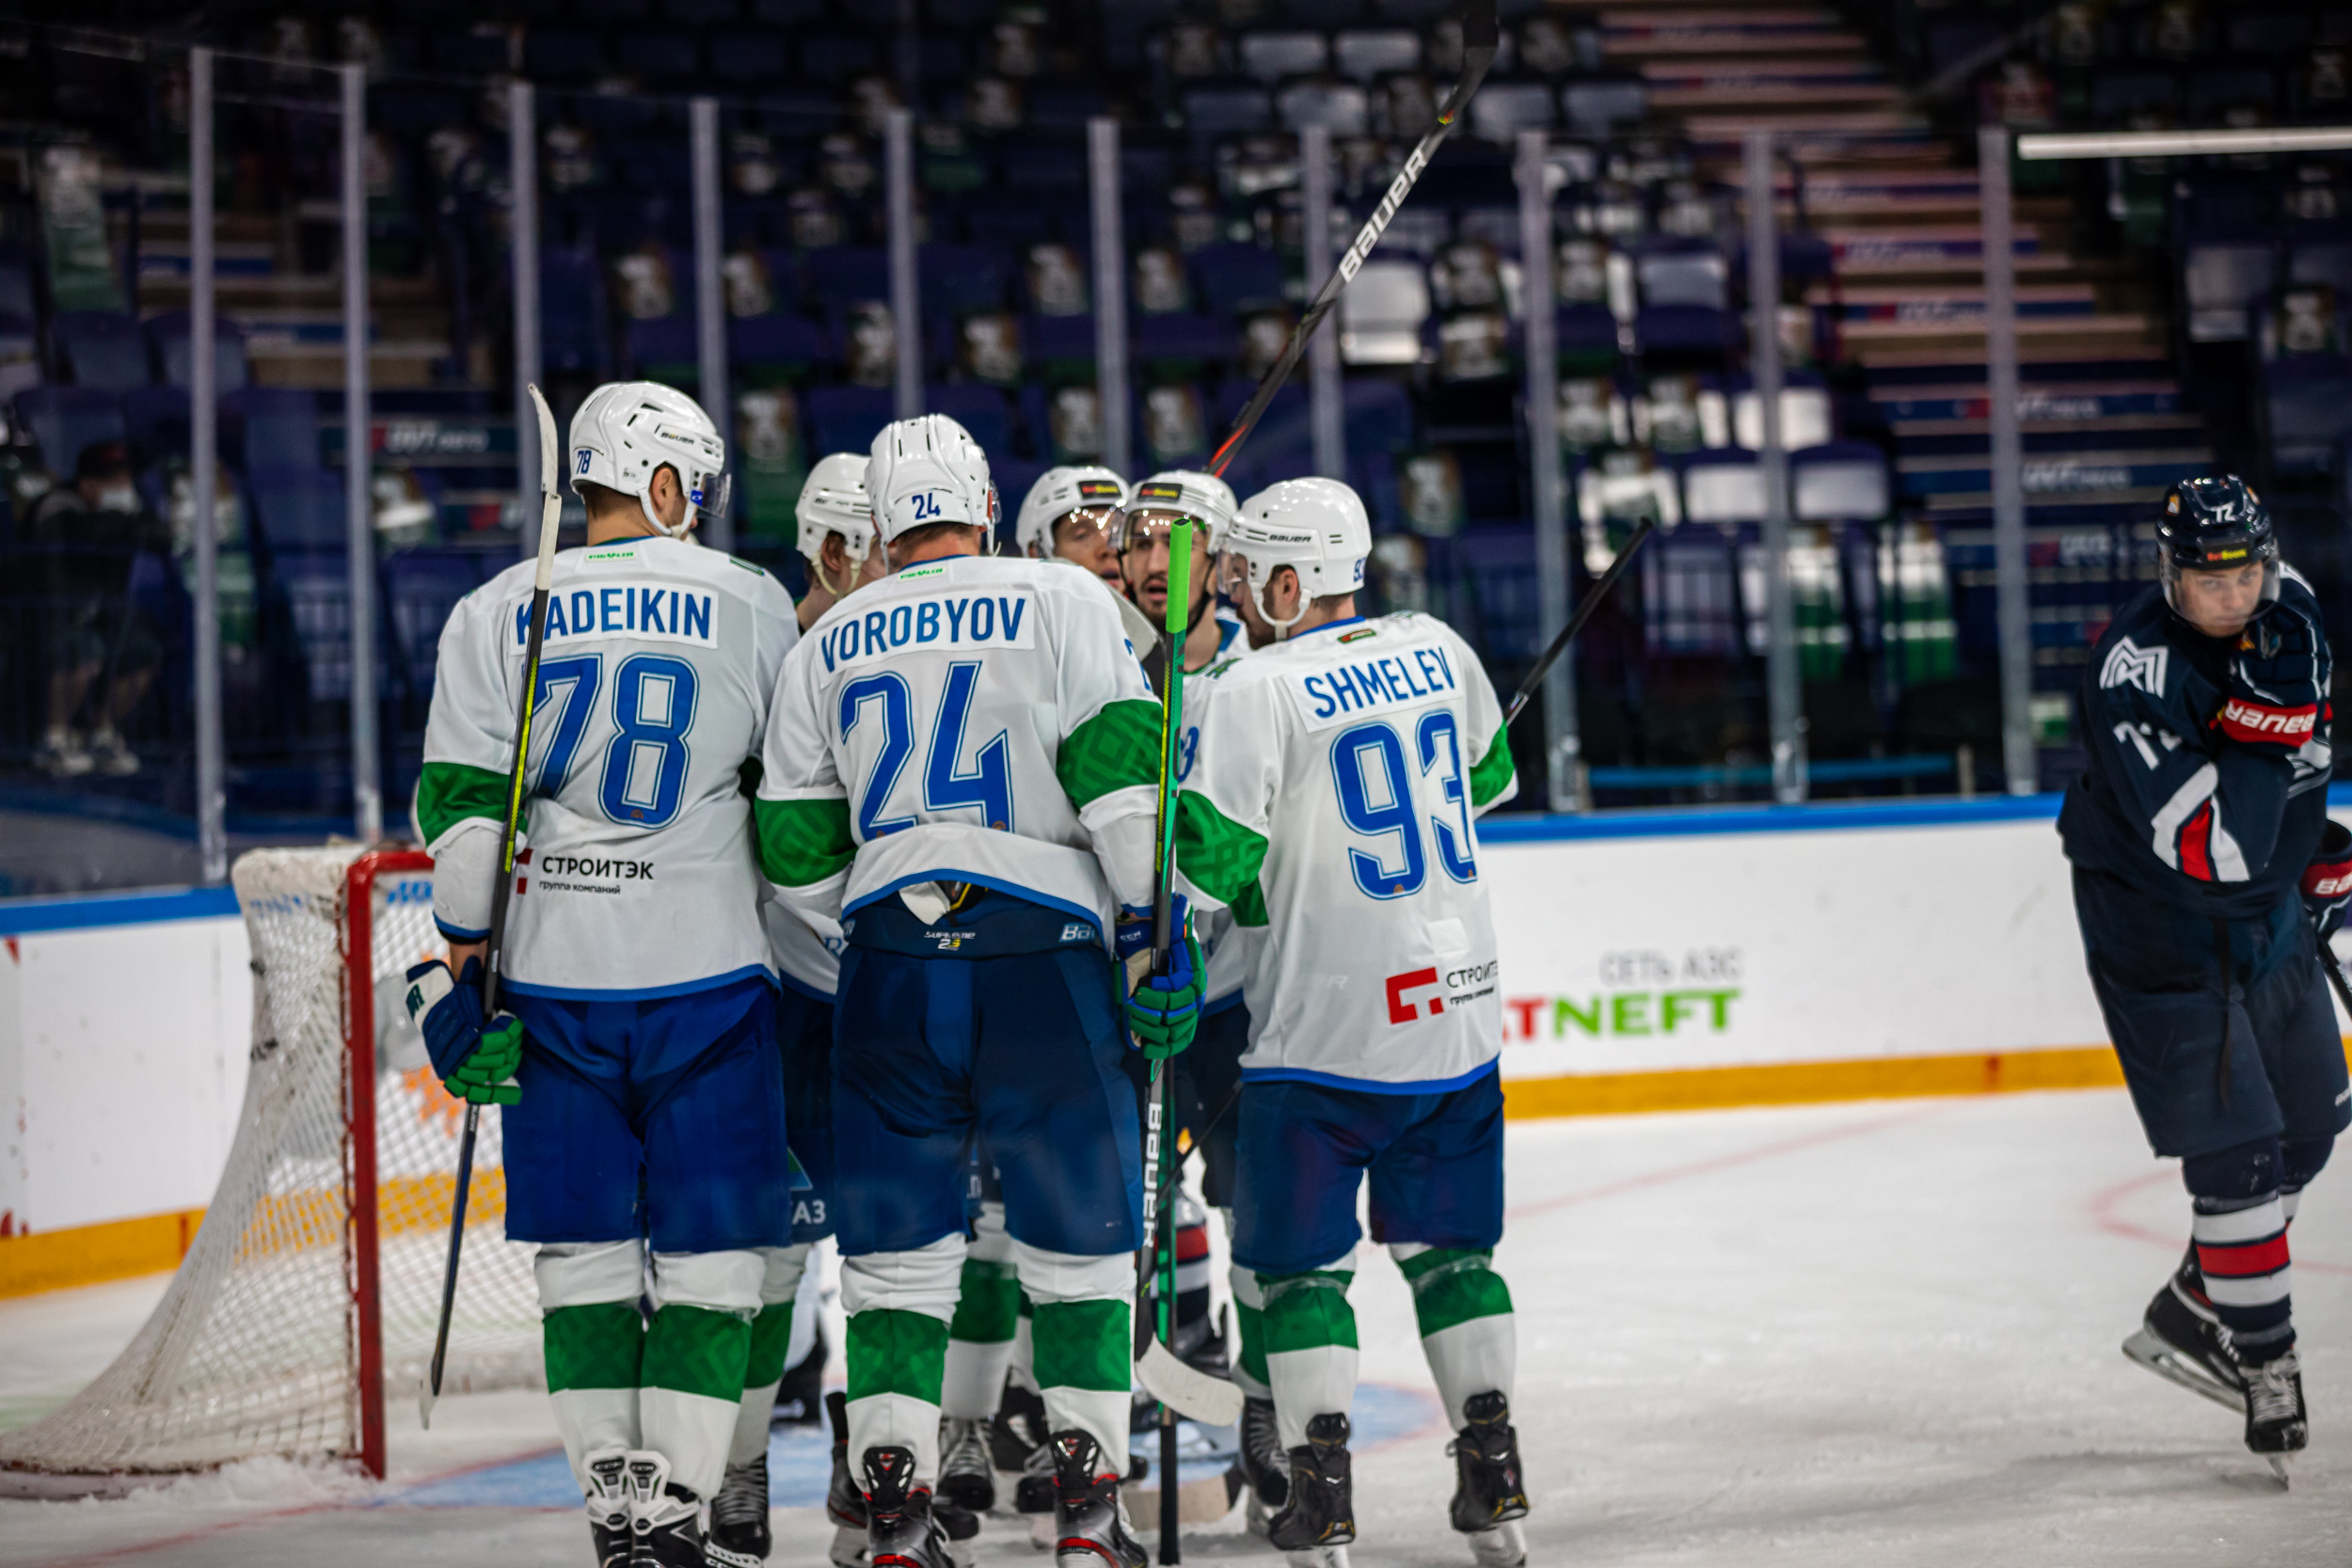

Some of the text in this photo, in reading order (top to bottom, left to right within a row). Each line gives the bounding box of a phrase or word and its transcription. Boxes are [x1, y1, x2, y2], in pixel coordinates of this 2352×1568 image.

[577, 450, 592, 475] 78
[912, 493, 941, 520] 24
[1270, 534, 1311, 543] BAUER
[516, 587, 711, 645] KADEIKIN
[820, 597, 1025, 673] VOROBYOV
[1304, 646, 1455, 719] SHMELEV
[521, 653, 700, 830] 78
[838, 660, 1015, 844] 24
[1179, 726, 1200, 784] 3
[1329, 709, 1478, 900] 93
[539, 880, 621, 895] группа компаний
[542, 856, 655, 880] СТРОИТЭК
[1142, 1102, 1162, 1248] BAUER
